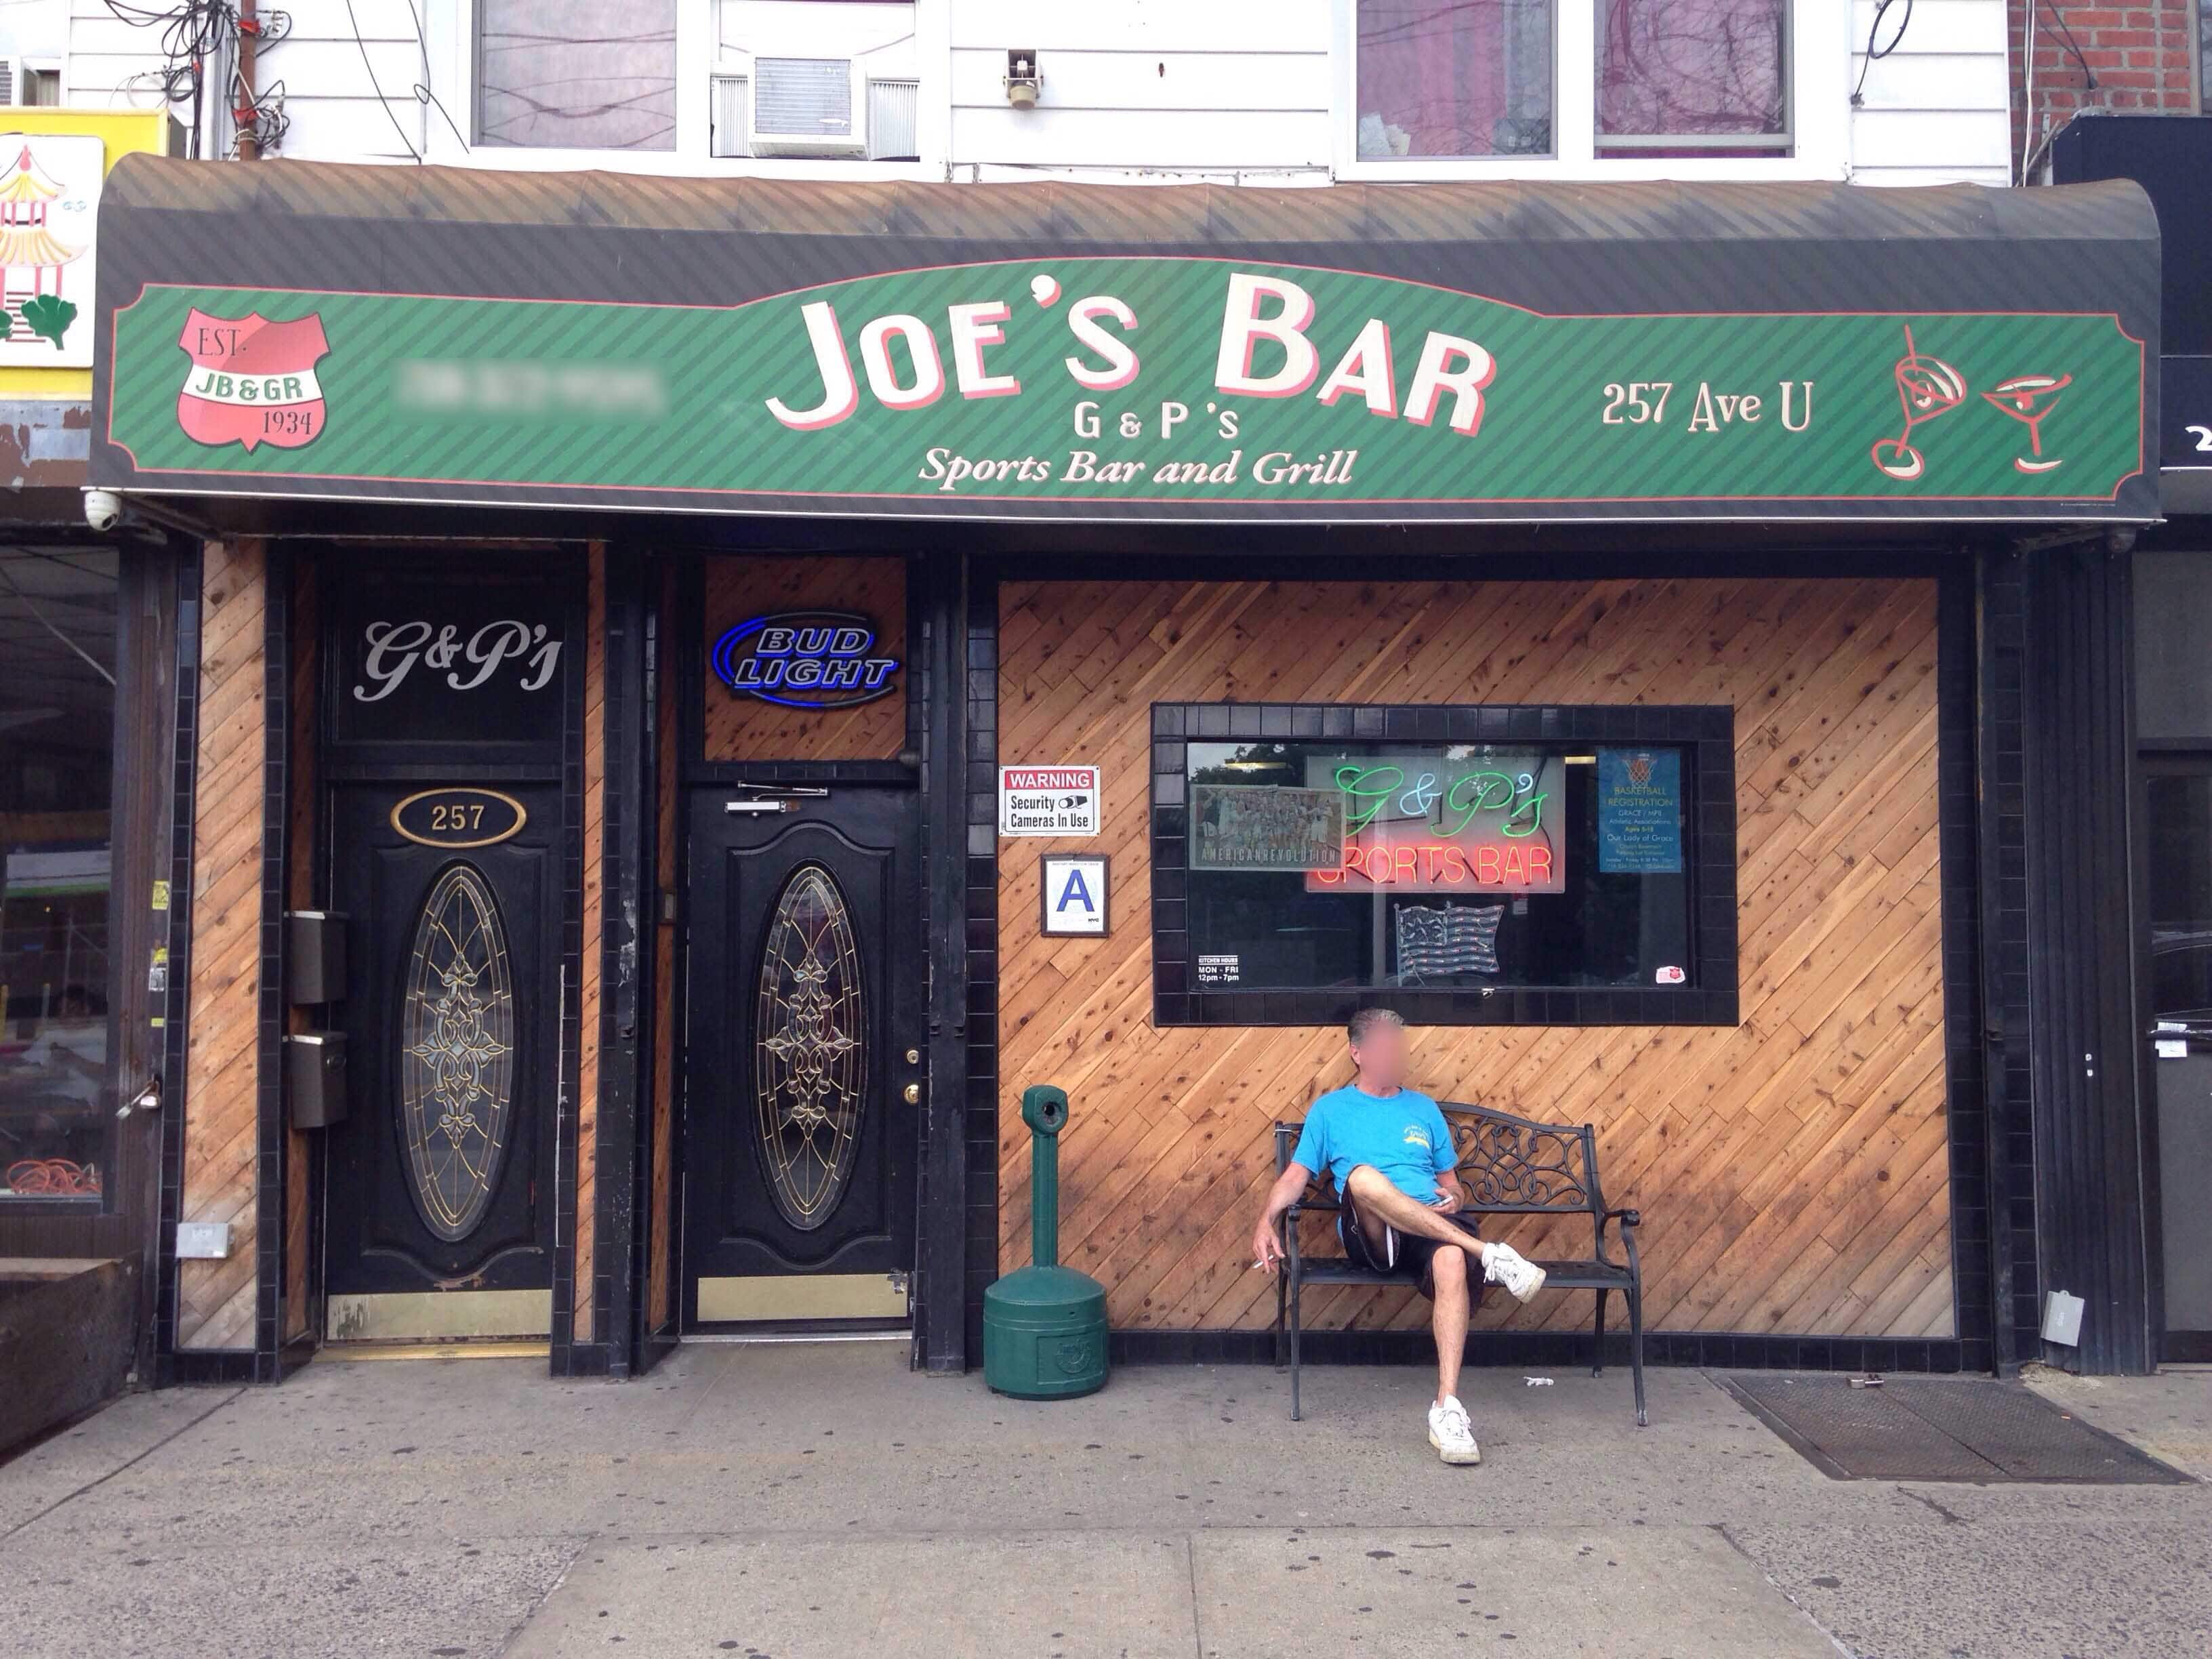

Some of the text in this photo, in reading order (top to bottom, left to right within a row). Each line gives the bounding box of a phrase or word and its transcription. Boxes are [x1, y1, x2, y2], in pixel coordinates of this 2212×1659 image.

[198, 328, 247, 356] EST.
[764, 272, 1496, 437] JOE'S BAR
[195, 373, 303, 401] JB&GR
[1602, 381, 1814, 432] 257 Ave U
[264, 410, 312, 435] 1934
[918, 447, 1357, 491] Sports Bar and Grill
[755, 628, 875, 657] BUD
[734, 659, 899, 689] LIGHT
[1010, 773, 1090, 788] WARNING
[1614, 786, 1666, 796] BASKETBALL
[1010, 795, 1055, 812] Security
[1607, 797, 1673, 806] REGISTRATION
[431, 805, 485, 830] 257
[1010, 813, 1088, 827] Cameras In Use
[1607, 834, 1621, 842] Our
[1623, 834, 1640, 842] Lady
[1478, 846, 1552, 884] BAR
[1056, 869, 1095, 912] A
